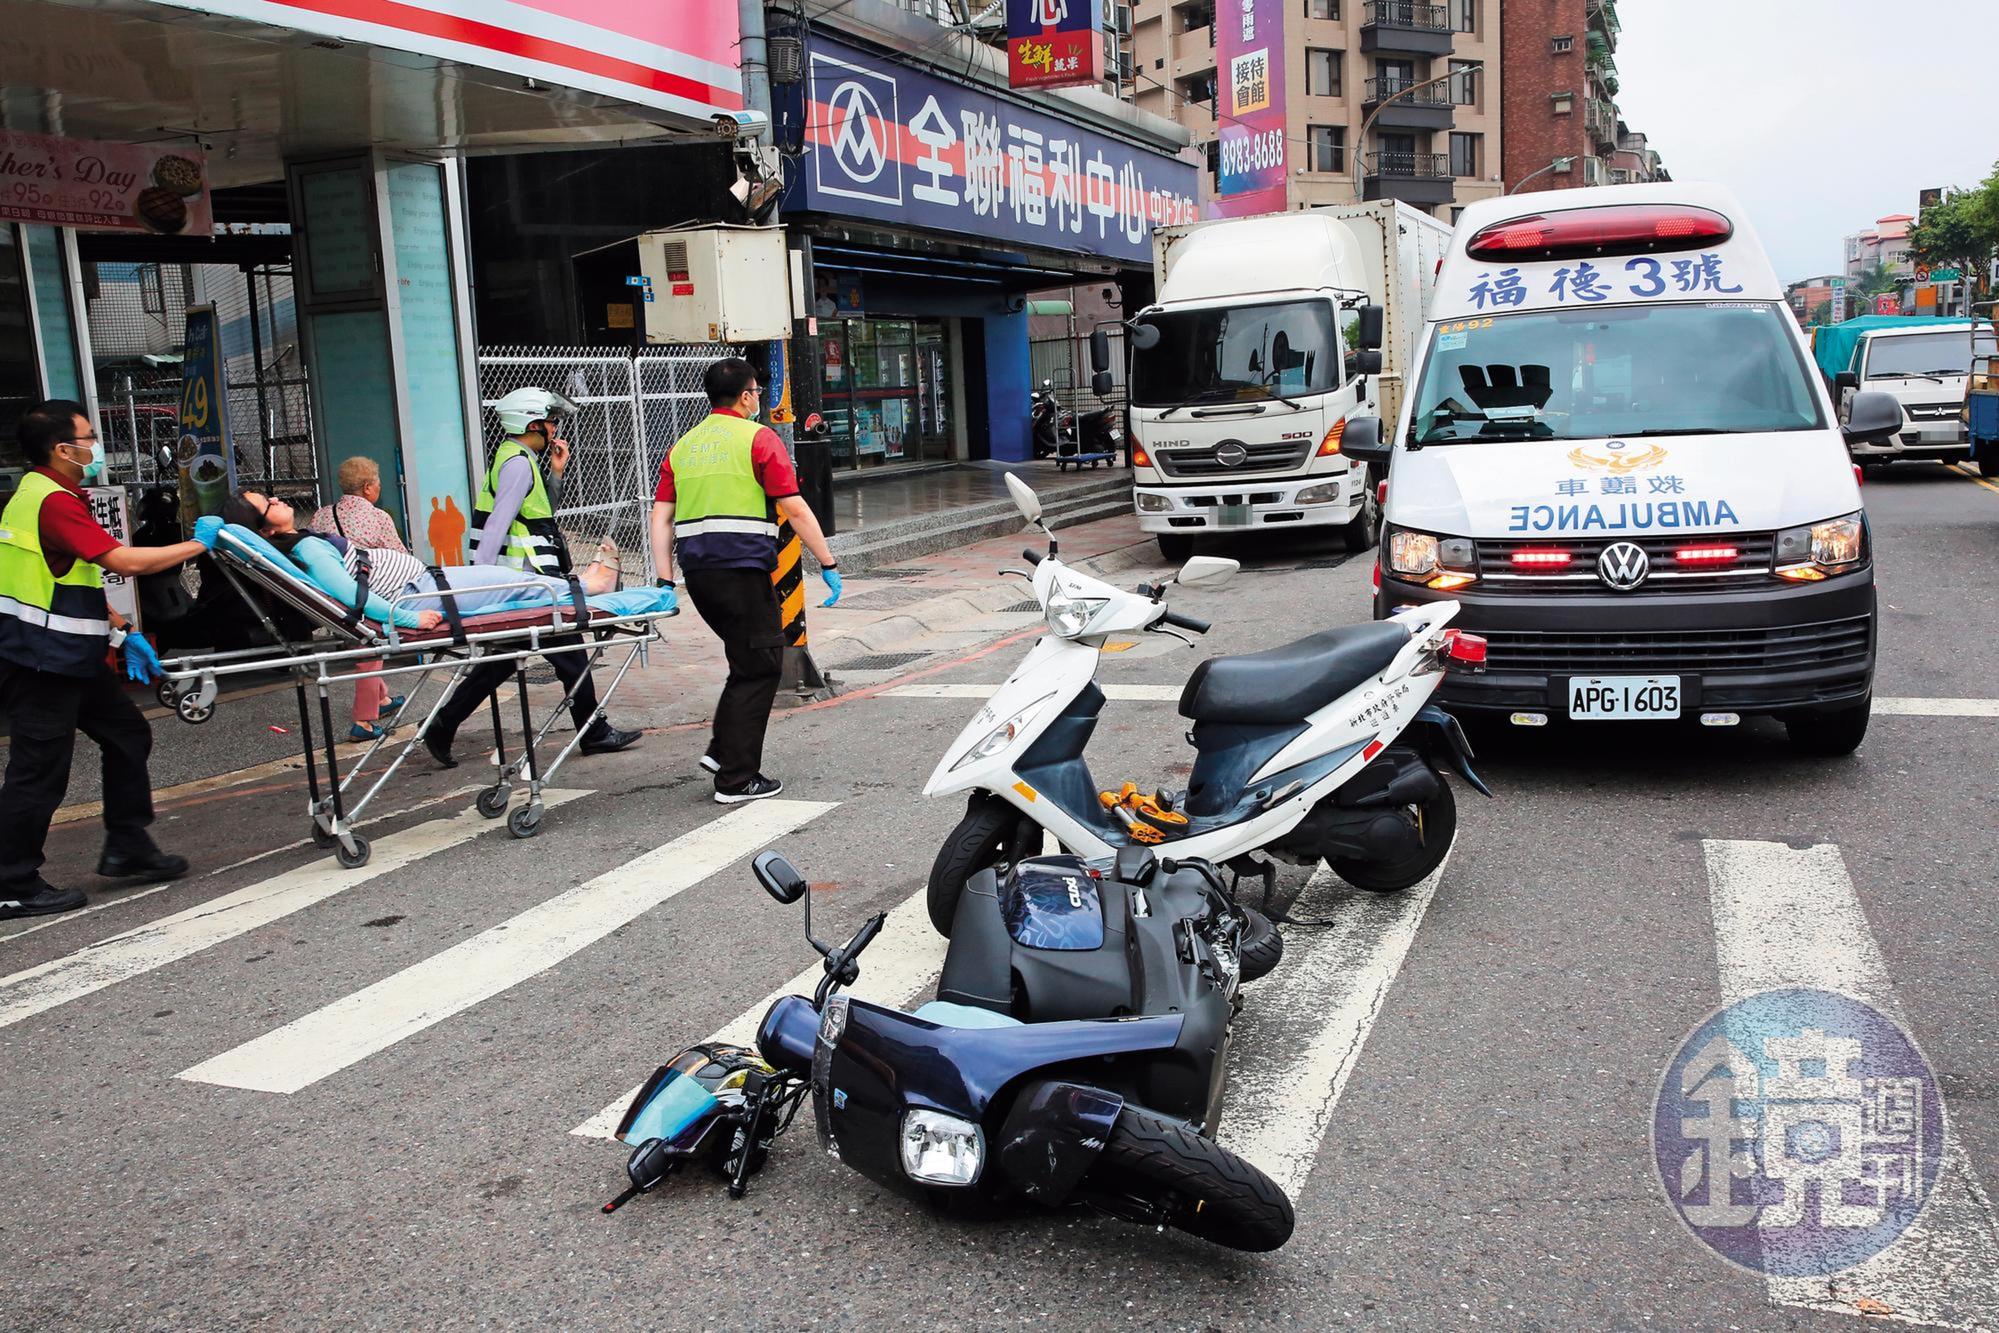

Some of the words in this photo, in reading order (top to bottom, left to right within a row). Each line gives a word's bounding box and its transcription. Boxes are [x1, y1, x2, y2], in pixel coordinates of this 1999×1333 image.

[1017, 39, 1054, 74] 生鮮
[1236, 57, 1264, 85] 接待
[1237, 81, 1265, 109] 會館
[909, 94, 1147, 244] 全聯福利中心
[1223, 128, 1283, 177] 8983-8688
[73, 155, 137, 194] Day
[1467, 253, 1744, 310] 福德3號
[182, 376, 209, 430] 49
[1281, 431, 1313, 440] 500
